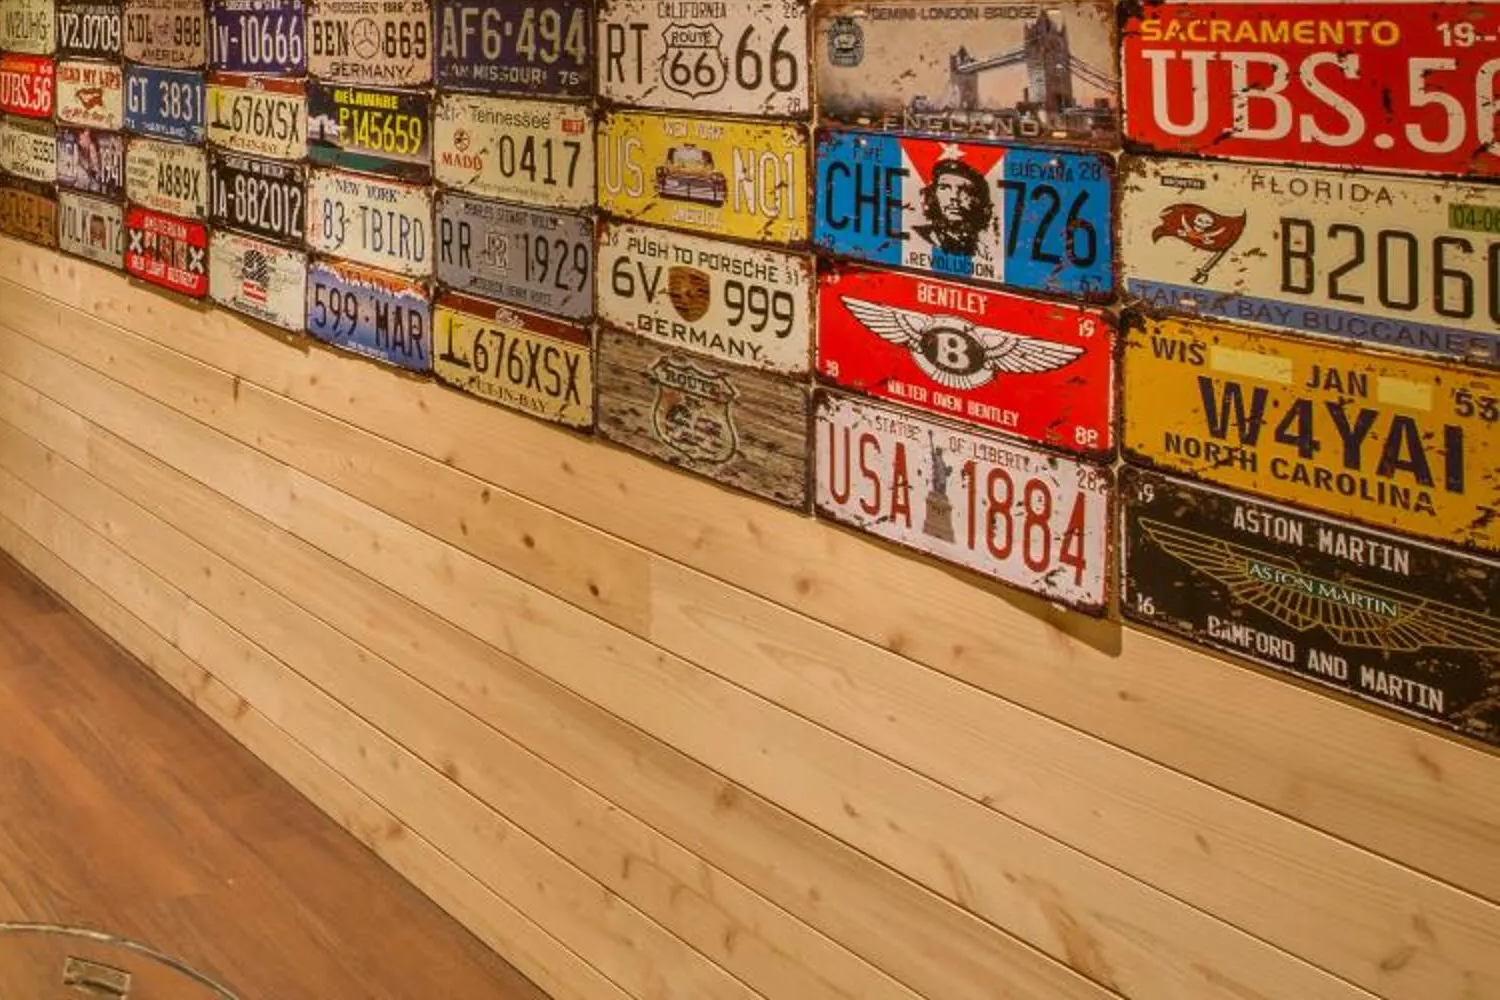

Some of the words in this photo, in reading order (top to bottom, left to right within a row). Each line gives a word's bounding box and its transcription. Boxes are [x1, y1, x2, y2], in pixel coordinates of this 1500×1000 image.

[658, 1, 726, 18] CALIFORNIA
[921, 8, 978, 19] LONDON
[985, 6, 1037, 19] BRIDGE
[313, 20, 349, 56] BEN
[671, 31, 712, 44] ROUTE
[1141, 20, 1399, 45] SACRAMENTO
[330, 63, 406, 76] GERMANY
[607, 23, 648, 84] RT
[736, 24, 798, 92] 66
[671, 51, 715, 86] 66
[0, 72, 51, 113] UBS.56
[129, 77, 148, 114] GT
[159, 80, 202, 123] 3831
[471, 108, 550, 130] Tennessee
[883, 112, 1040, 136] ENGLAND
[500, 135, 580, 188] 0417
[602, 135, 644, 197] US
[336, 179, 359, 195] NEW
[366, 186, 398, 202] YORK
[1251, 175, 1392, 203] FLORIDA
[826, 161, 910, 240] CHE
[997, 180, 1096, 267] 726
[441, 218, 471, 268] RR
[523, 233, 588, 293] 1929
[628, 237, 668, 259] PUSH
[672, 245, 693, 264] TO
[700, 252, 780, 282] PORSCHE
[1280, 218, 1500, 331] B206
[611, 256, 662, 304] 6V
[724, 280, 794, 339] 999
[917, 283, 987, 316] BENTLEY
[1137, 283, 1228, 314] TAMPA
[1234, 301, 1293, 326] BAY
[637, 314, 765, 361] GERMANY
[936, 331, 968, 369] B
[1152, 336, 1206, 366] WIS
[1306, 365, 1368, 397] JAN
[967, 403, 1020, 427] BENTLEY
[1198, 376, 1464, 494] W4YAI
[950, 435, 965, 452] OF
[1165, 433, 1257, 472] NORTH
[1270, 458, 1436, 516] CAROLINA
[830, 421, 912, 528] USA
[962, 460, 1086, 587] 1884
[1234, 506, 1303, 546] ASTON
[1319, 528, 1409, 576] MARTIN
[1249, 564, 1315, 594] ASTON
[1318, 585, 1397, 616] MARTIN
[1207, 615, 1295, 662] BAMFORD
[1308, 650, 1346, 679] AND
[1361, 664, 1443, 713] MARTIN
